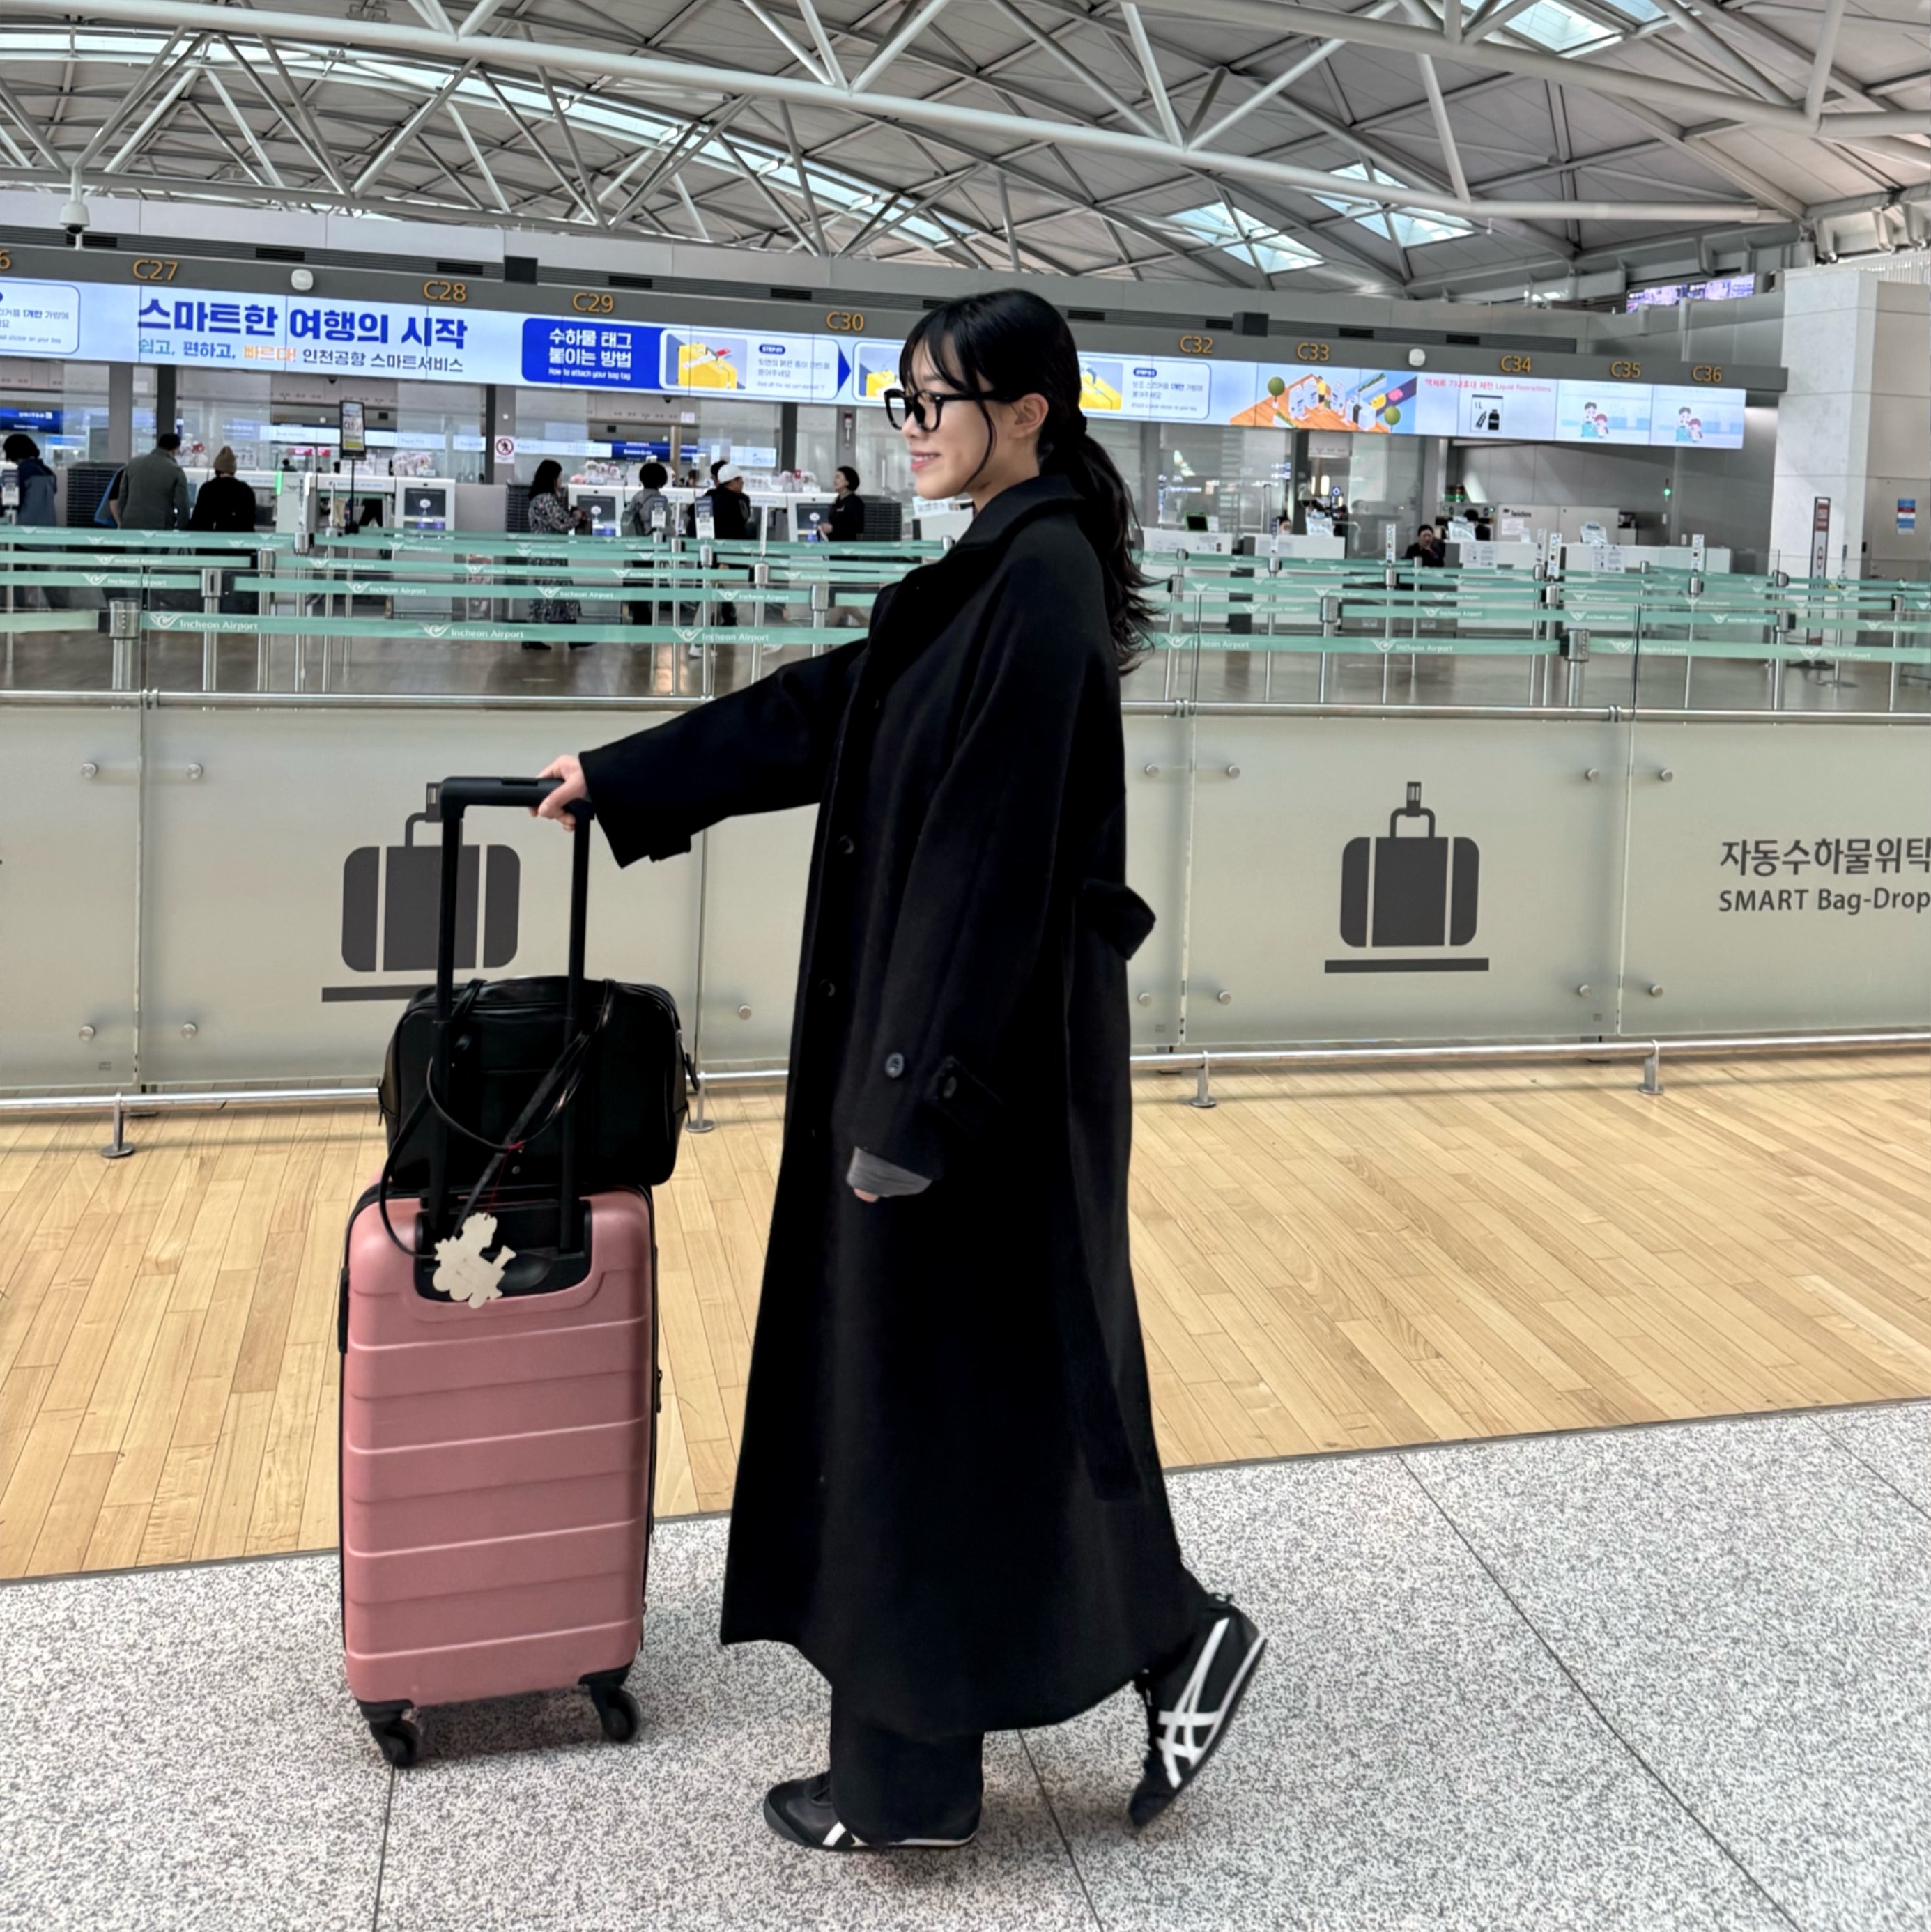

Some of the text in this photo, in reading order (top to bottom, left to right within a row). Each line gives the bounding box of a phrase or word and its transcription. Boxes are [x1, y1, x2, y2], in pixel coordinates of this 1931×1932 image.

[132, 258, 179, 281] C27
[423, 280, 467, 302] C28
[572, 293, 614, 314] C29
[138, 298, 468, 349] 스마트한 여행의 시작
[826, 311, 865, 332] C30
[549, 327, 632, 349] 수하물 태그
[1179, 335, 1213, 354] C32
[139, 339, 463, 373] 쉽고, 편하고, 빠르다! 인천공항 스마트서비스
[549, 346, 632, 369] 붙이는 방법
[1297, 343, 1330, 362] C33
[1500, 355, 1532, 373] C34
[1610, 361, 1641, 378] C35
[571, 369, 592, 378] attach
[593, 371, 607, 380] your
[608, 370, 620, 380] bag
[620, 371, 631, 381] tag
[1692, 365, 1722, 382] C36
[1495, 382, 1514, 391] Liquid
[1516, 384, 1552, 392] Restrictions
[1511, 509, 1532, 518] leidos
[107, 578, 167, 587] Incheon Airport
[180, 619, 258, 632] Incheon Airport
[452, 628, 523, 640] Incheon Airport
[702, 632, 769, 642] Incheon Airport
[1222, 640, 1249, 650] Airport
[1396, 642, 1453, 654] Incheon Airport
[1661, 646, 1687, 656] Airport
[1718, 887, 1930, 916] SMART Bag-Drop
